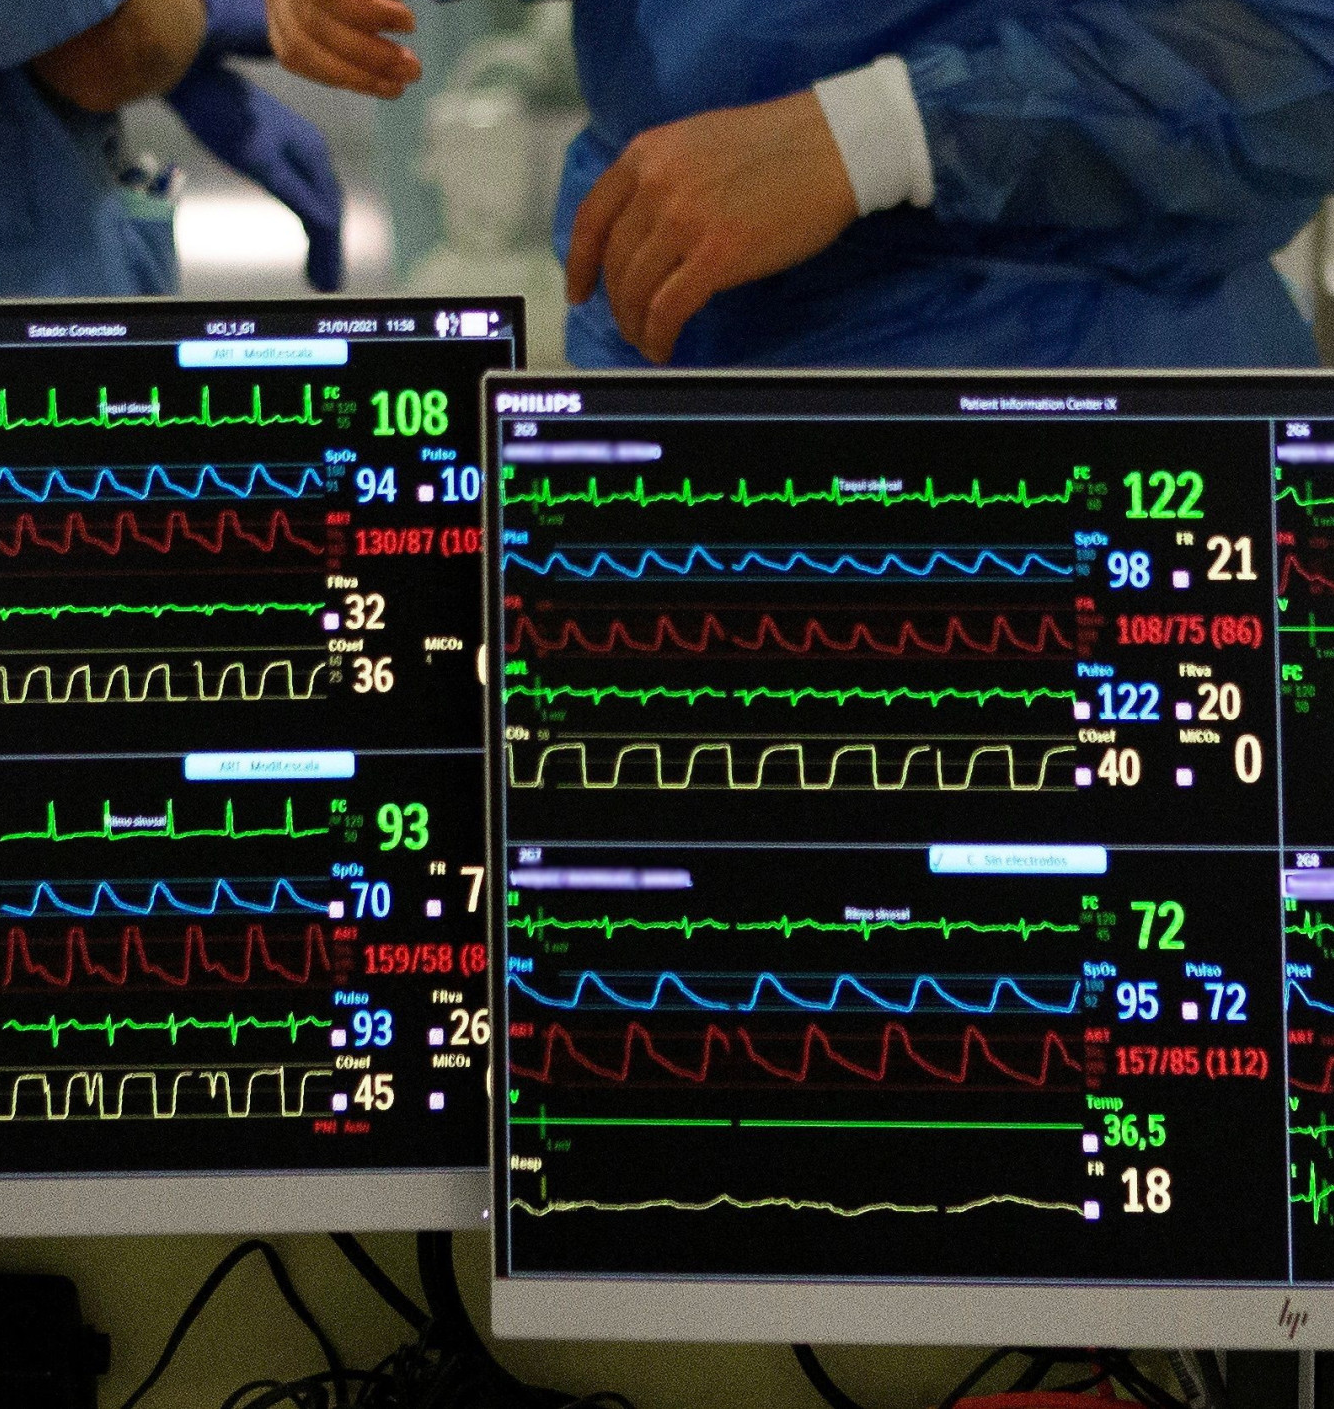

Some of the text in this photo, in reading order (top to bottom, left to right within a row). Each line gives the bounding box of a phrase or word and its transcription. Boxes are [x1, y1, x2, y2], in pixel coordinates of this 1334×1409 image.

[371, 389, 449, 437] 108
[496, 392, 581, 413] PHILIPS
[421, 447, 457, 461] Pulso
[356, 467, 397, 503] 94
[1123, 471, 1204, 519] 122
[355, 527, 435, 556] 130/87
[1207, 536, 1257, 580] 21
[1107, 551, 1150, 588] 98
[344, 593, 386, 630] 32
[1117, 614, 1206, 644] 108/75
[1210, 614, 1263, 649] (86)
[352, 657, 394, 693] 36
[1281, 665, 1303, 681] FC
[1097, 683, 1160, 720] 122
[1197, 683, 1242, 720] 20
[1097, 748, 1141, 786] 40
[1235, 734, 1263, 784] 0
[377, 803, 429, 851] 93
[351, 881, 391, 918] 70
[1082, 895, 1099, 910] FC
[1131, 900, 1185, 950] 72
[365, 944, 453, 974] 159/58
[1185, 962, 1222, 977] Pulso
[335, 991, 369, 1005] Pulso
[1116, 981, 1159, 1020] 95
[1204, 982, 1247, 1021] 72
[353, 1009, 393, 1047] 93
[450, 1008, 491, 1046] 26
[1116, 1046, 1200, 1076] 157/85
[1205, 1046, 1268, 1080] (112)
[354, 1073, 395, 1110] 45
[1086, 1094, 1123, 1111] Temp
[1104, 1114, 1166, 1150] 36,5
[1087, 1161, 1105, 1176] FR
[1121, 1167, 1171, 1213] 18
[1279, 1297, 1308, 1339] hp
